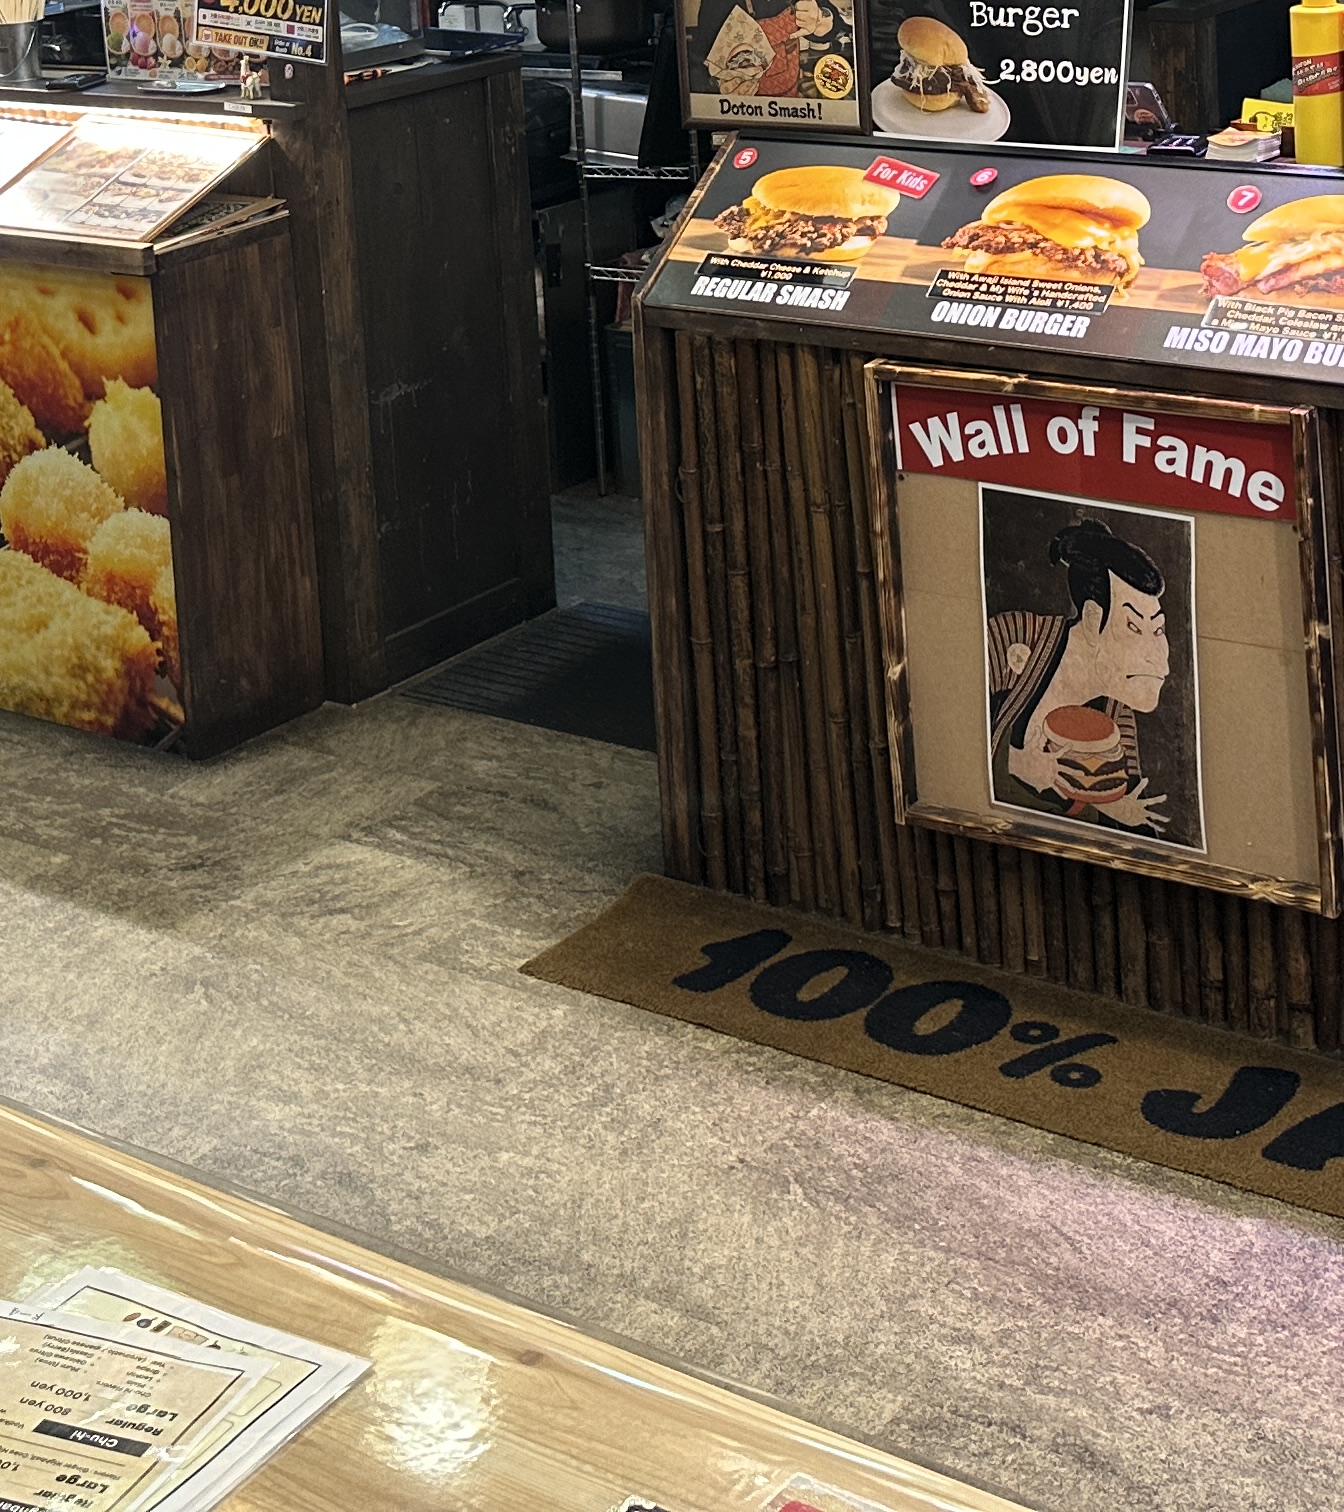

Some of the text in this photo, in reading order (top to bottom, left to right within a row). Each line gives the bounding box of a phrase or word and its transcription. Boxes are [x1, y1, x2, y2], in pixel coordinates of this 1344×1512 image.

[294, 3, 323, 24] YEN
[969, 2, 1080, 36] Burger
[214, 30, 232, 44] TAKE
[998, 57, 1119, 87] 2,800yen
[719, 98, 823, 121] Doton Smash!
[872, 161, 928, 193] For Kids
[691, 275, 851, 312] REGULAR SMASH
[931, 300, 1091, 339] ONION BURGER
[1163, 326, 1230, 354] MISO
[1230, 333, 1304, 362] MAYO
[909, 403, 1286, 512] Wall of Fame
[673, 926, 1120, 1092] 100%
[105, 1416, 164, 1438] Regular
[126, 1401, 179, 1423] Large
[70, 1428, 119, 1448] Chu-hi
[55, 1472, 109, 1494] Large
